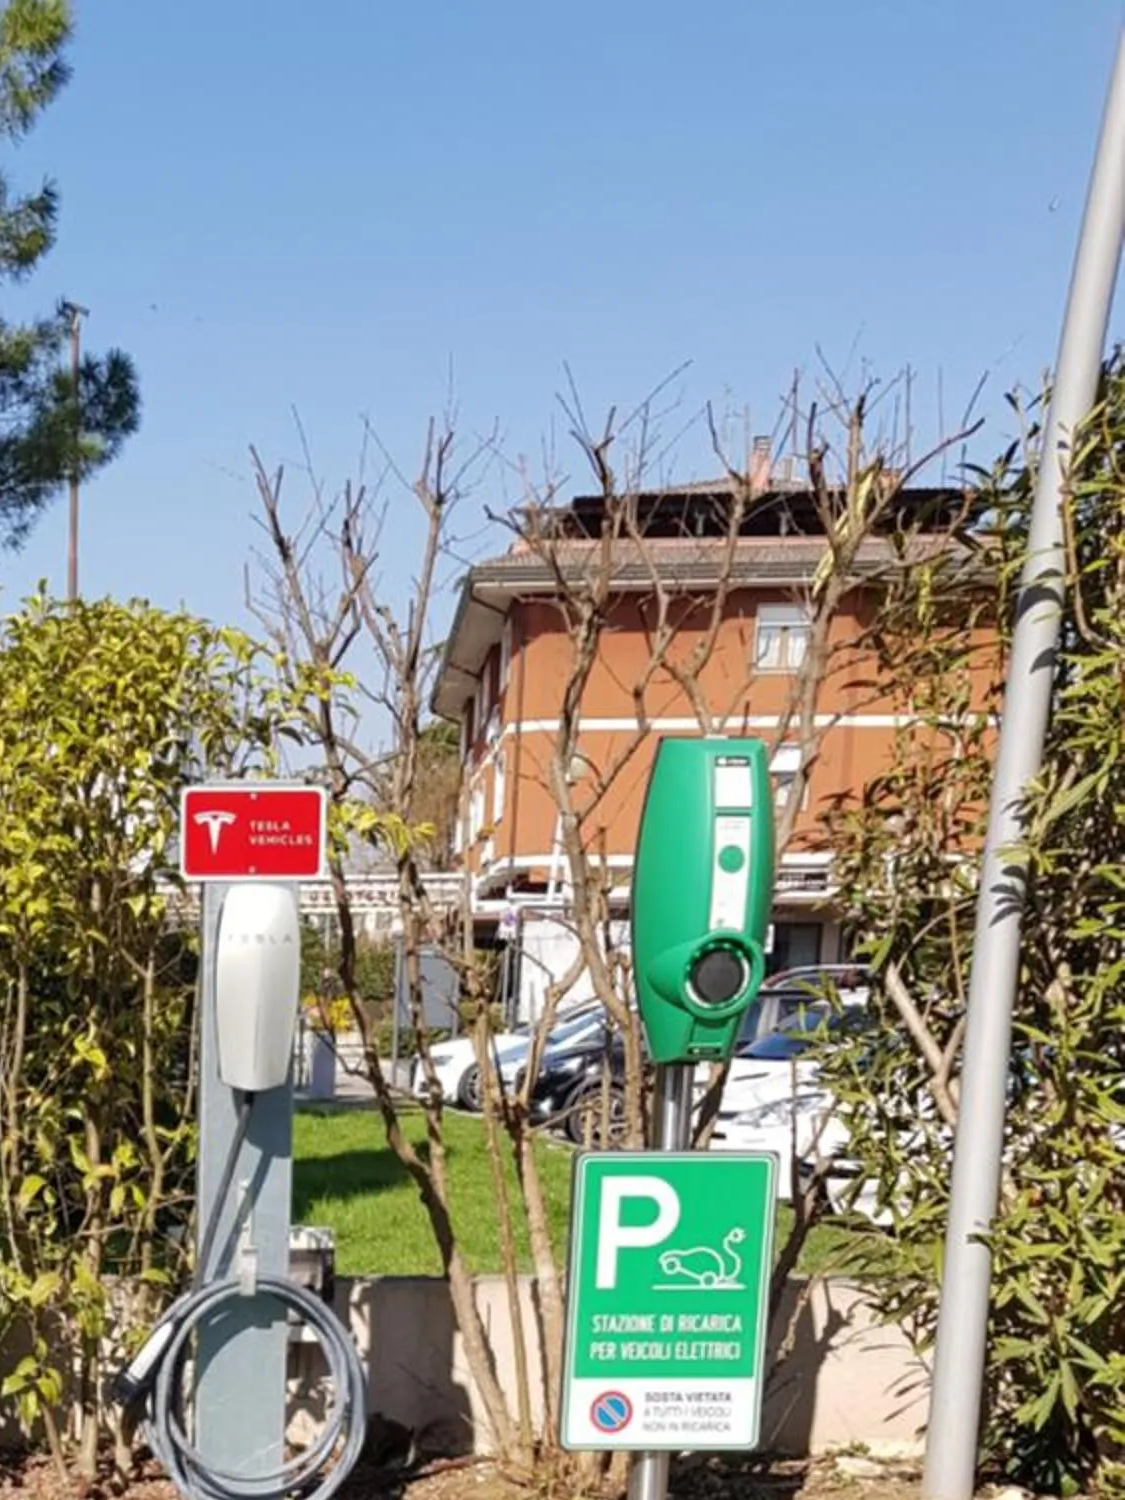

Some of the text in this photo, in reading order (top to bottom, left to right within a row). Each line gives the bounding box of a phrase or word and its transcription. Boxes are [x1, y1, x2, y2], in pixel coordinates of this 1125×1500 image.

[249, 819, 291, 832] TESLA
[248, 833, 313, 846] VEHICLES
[595, 1174, 680, 1289] P
[591, 1314, 743, 1333] STAZIONE DI RICARICA
[589, 1341, 741, 1361] PER VEICOLI ELETTRICI
[644, 1391, 732, 1403] SOSTA VIETATA
